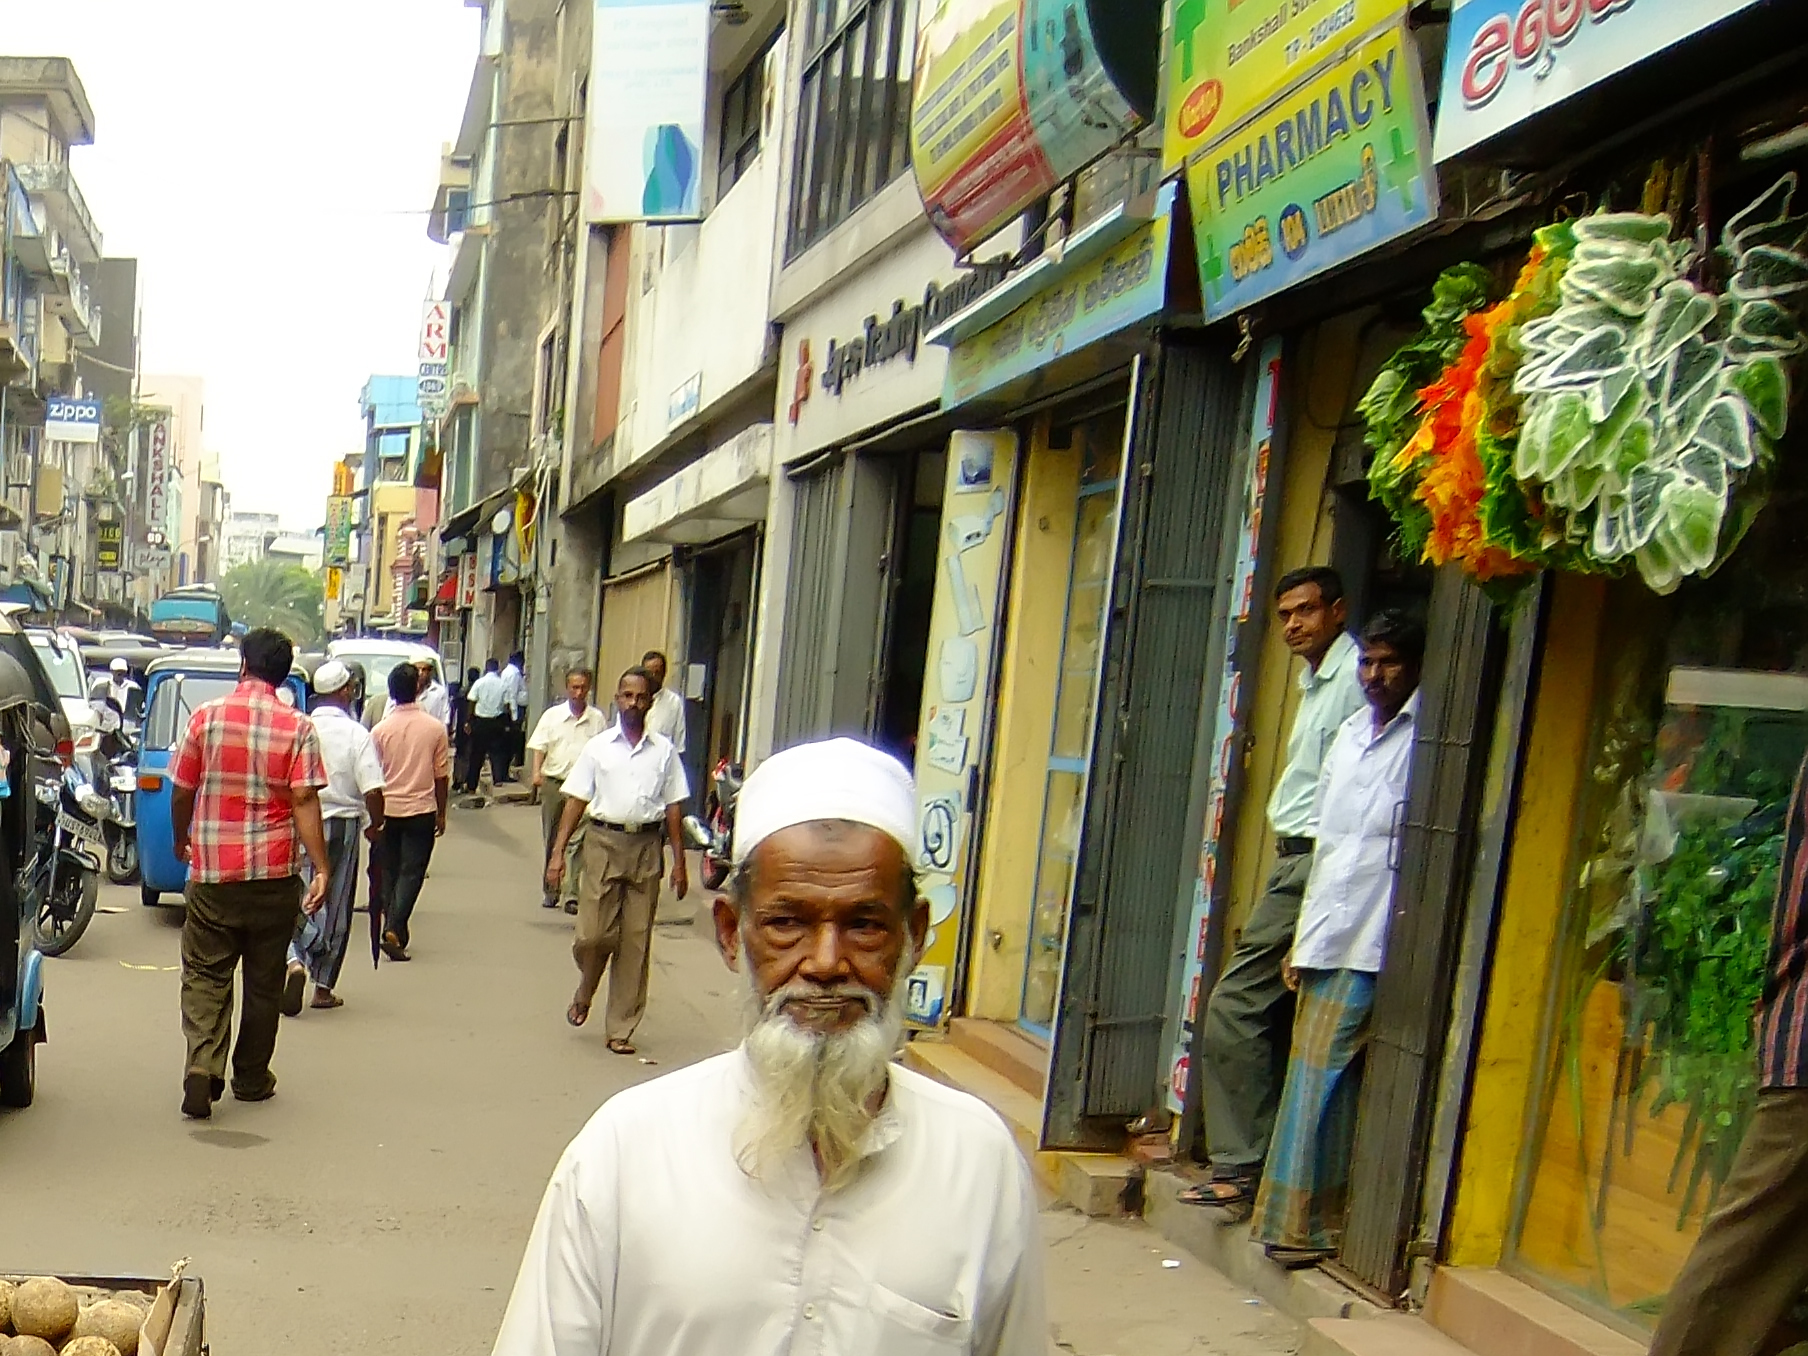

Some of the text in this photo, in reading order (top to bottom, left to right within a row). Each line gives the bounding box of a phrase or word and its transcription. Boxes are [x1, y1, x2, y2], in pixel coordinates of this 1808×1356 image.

[1227, 3, 1288, 67] Bankshall
[1215, 48, 1396, 211] PHARMACY
[422, 303, 446, 358] ARM
[49, 402, 96, 422] zippo
[150, 412, 167, 521] ANKSHALL
